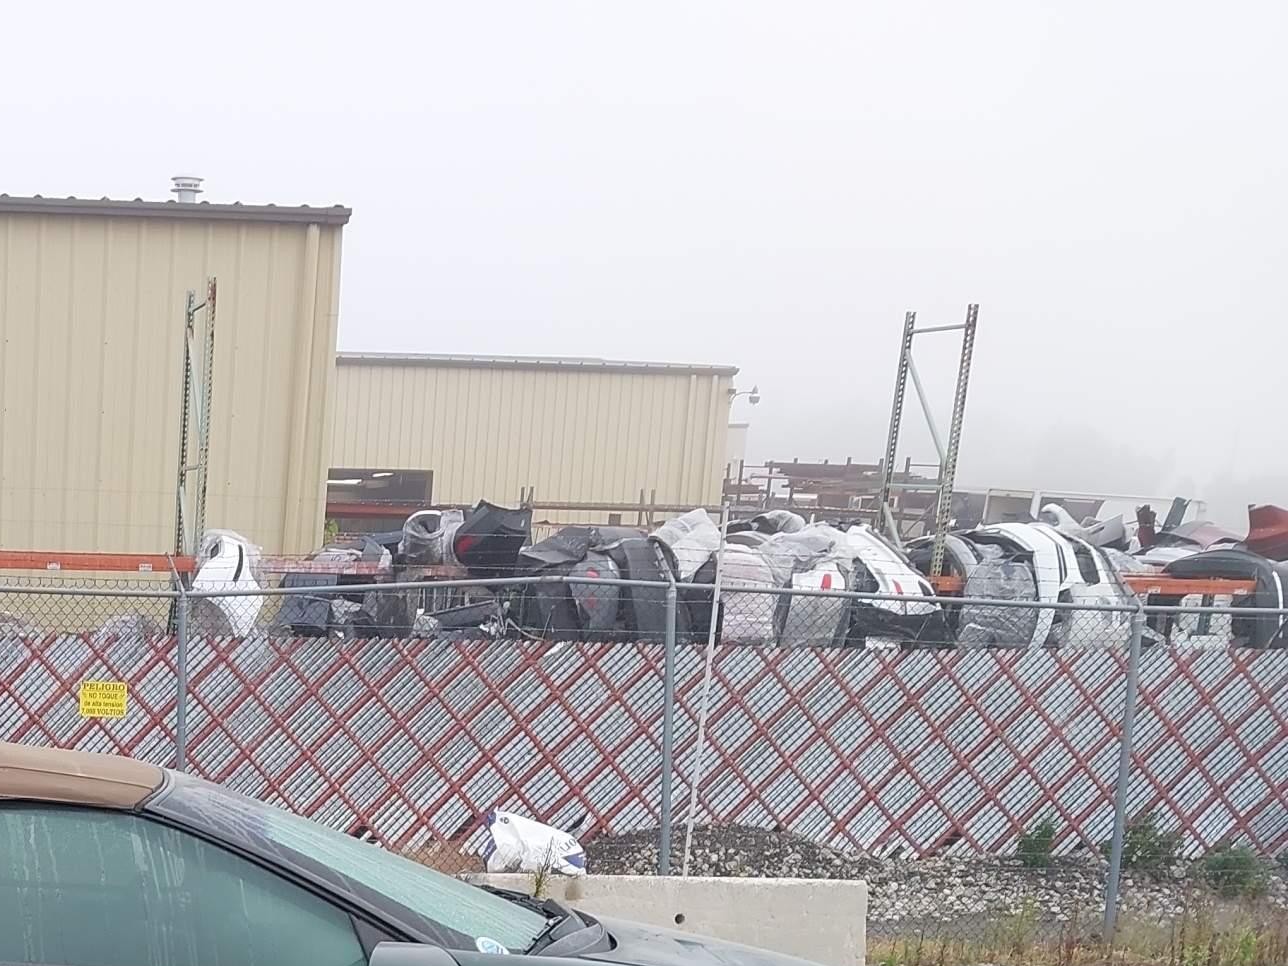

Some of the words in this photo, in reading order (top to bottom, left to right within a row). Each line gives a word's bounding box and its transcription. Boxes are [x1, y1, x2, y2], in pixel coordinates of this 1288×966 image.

[83, 682, 125, 691] PELIGRO
[99, 692, 118, 700] TOQUE
[97, 708, 124, 716] VOLTIOS
